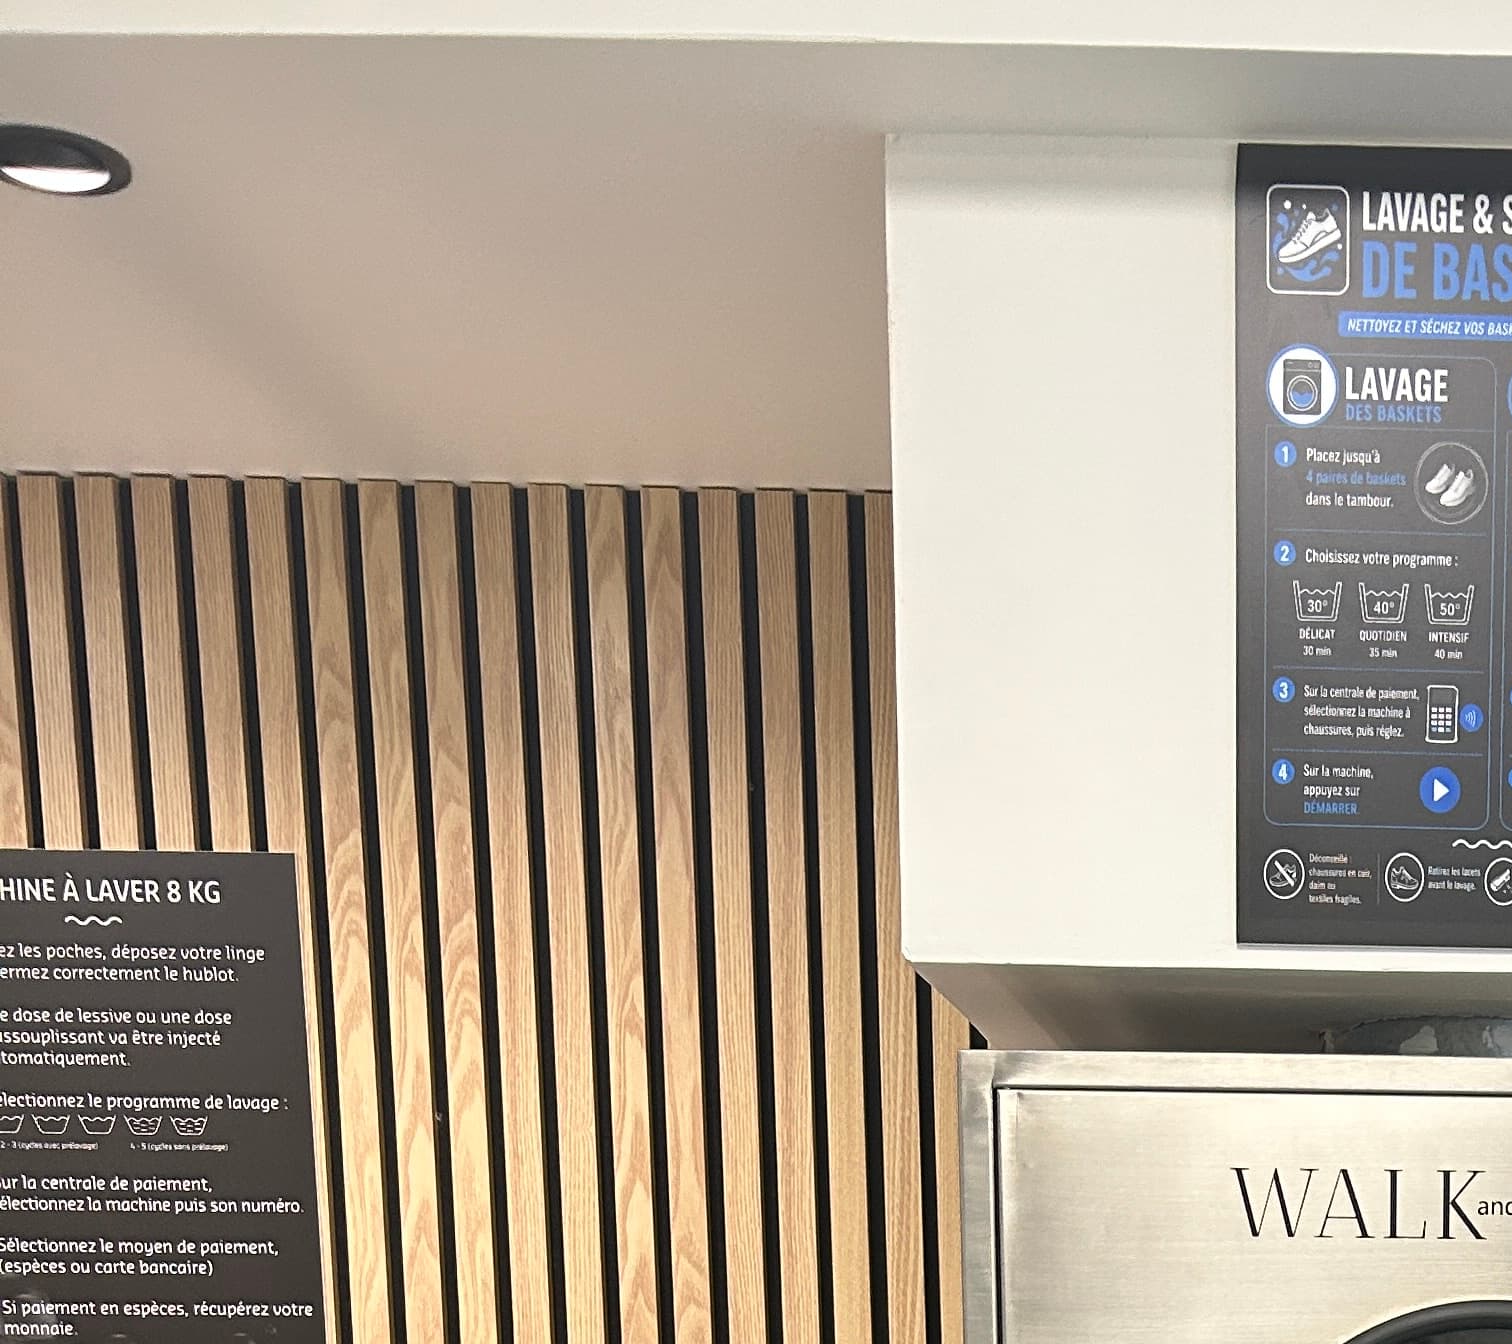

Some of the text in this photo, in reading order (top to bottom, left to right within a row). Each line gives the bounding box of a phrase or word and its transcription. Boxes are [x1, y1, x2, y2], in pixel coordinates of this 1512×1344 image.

[1363, 192, 1464, 233] LAVAGE
[1473, 195, 1493, 234] &
[1362, 241, 1416, 298] DE
[1348, 319, 1401, 332] NETTOYEZ
[1405, 320, 1417, 333] ET
[1420, 318, 1460, 334] SÉCHEZ
[1464, 322, 1485, 335] VOS
[1346, 367, 1448, 402] LAVAGE
[1346, 403, 1441, 422] DES BASKETS
[1282, 446, 1288, 462] 1
[1307, 448, 1380, 466] Placez jusqu'à
[1281, 545, 1289, 561] 2
[1306, 549, 1452, 568] Choisissez votre programme
[1308, 600, 1460, 615] 30° 40° 50°
[1300, 627, 1469, 643] DÉLICAT QUOTIDIEN INTENSIF
[63, 872, 79, 901] À
[86, 879, 160, 902] LAVER
[167, 881, 181, 902] 8
[189, 881, 220, 903] KG
[18, 943, 264, 963] les poches, déposez votre linge
[53, 966, 238, 981] correctement le hublot.
[1230, 1168, 1487, 1241] WALK
[99, 1238, 113, 1253] le
[119, 1242, 172, 1256] moyen
[177, 1240, 195, 1253] de
[201, 1240, 278, 1256] paiement,
[71, 1262, 90, 1273] ou
[95, 1261, 134, 1274] carte
[139, 1260, 213, 1276] bancaire)
[2, 1300, 312, 1318] Si paiement en espèces, récupérez votre
[5, 1321, 77, 1335] monnaie.
